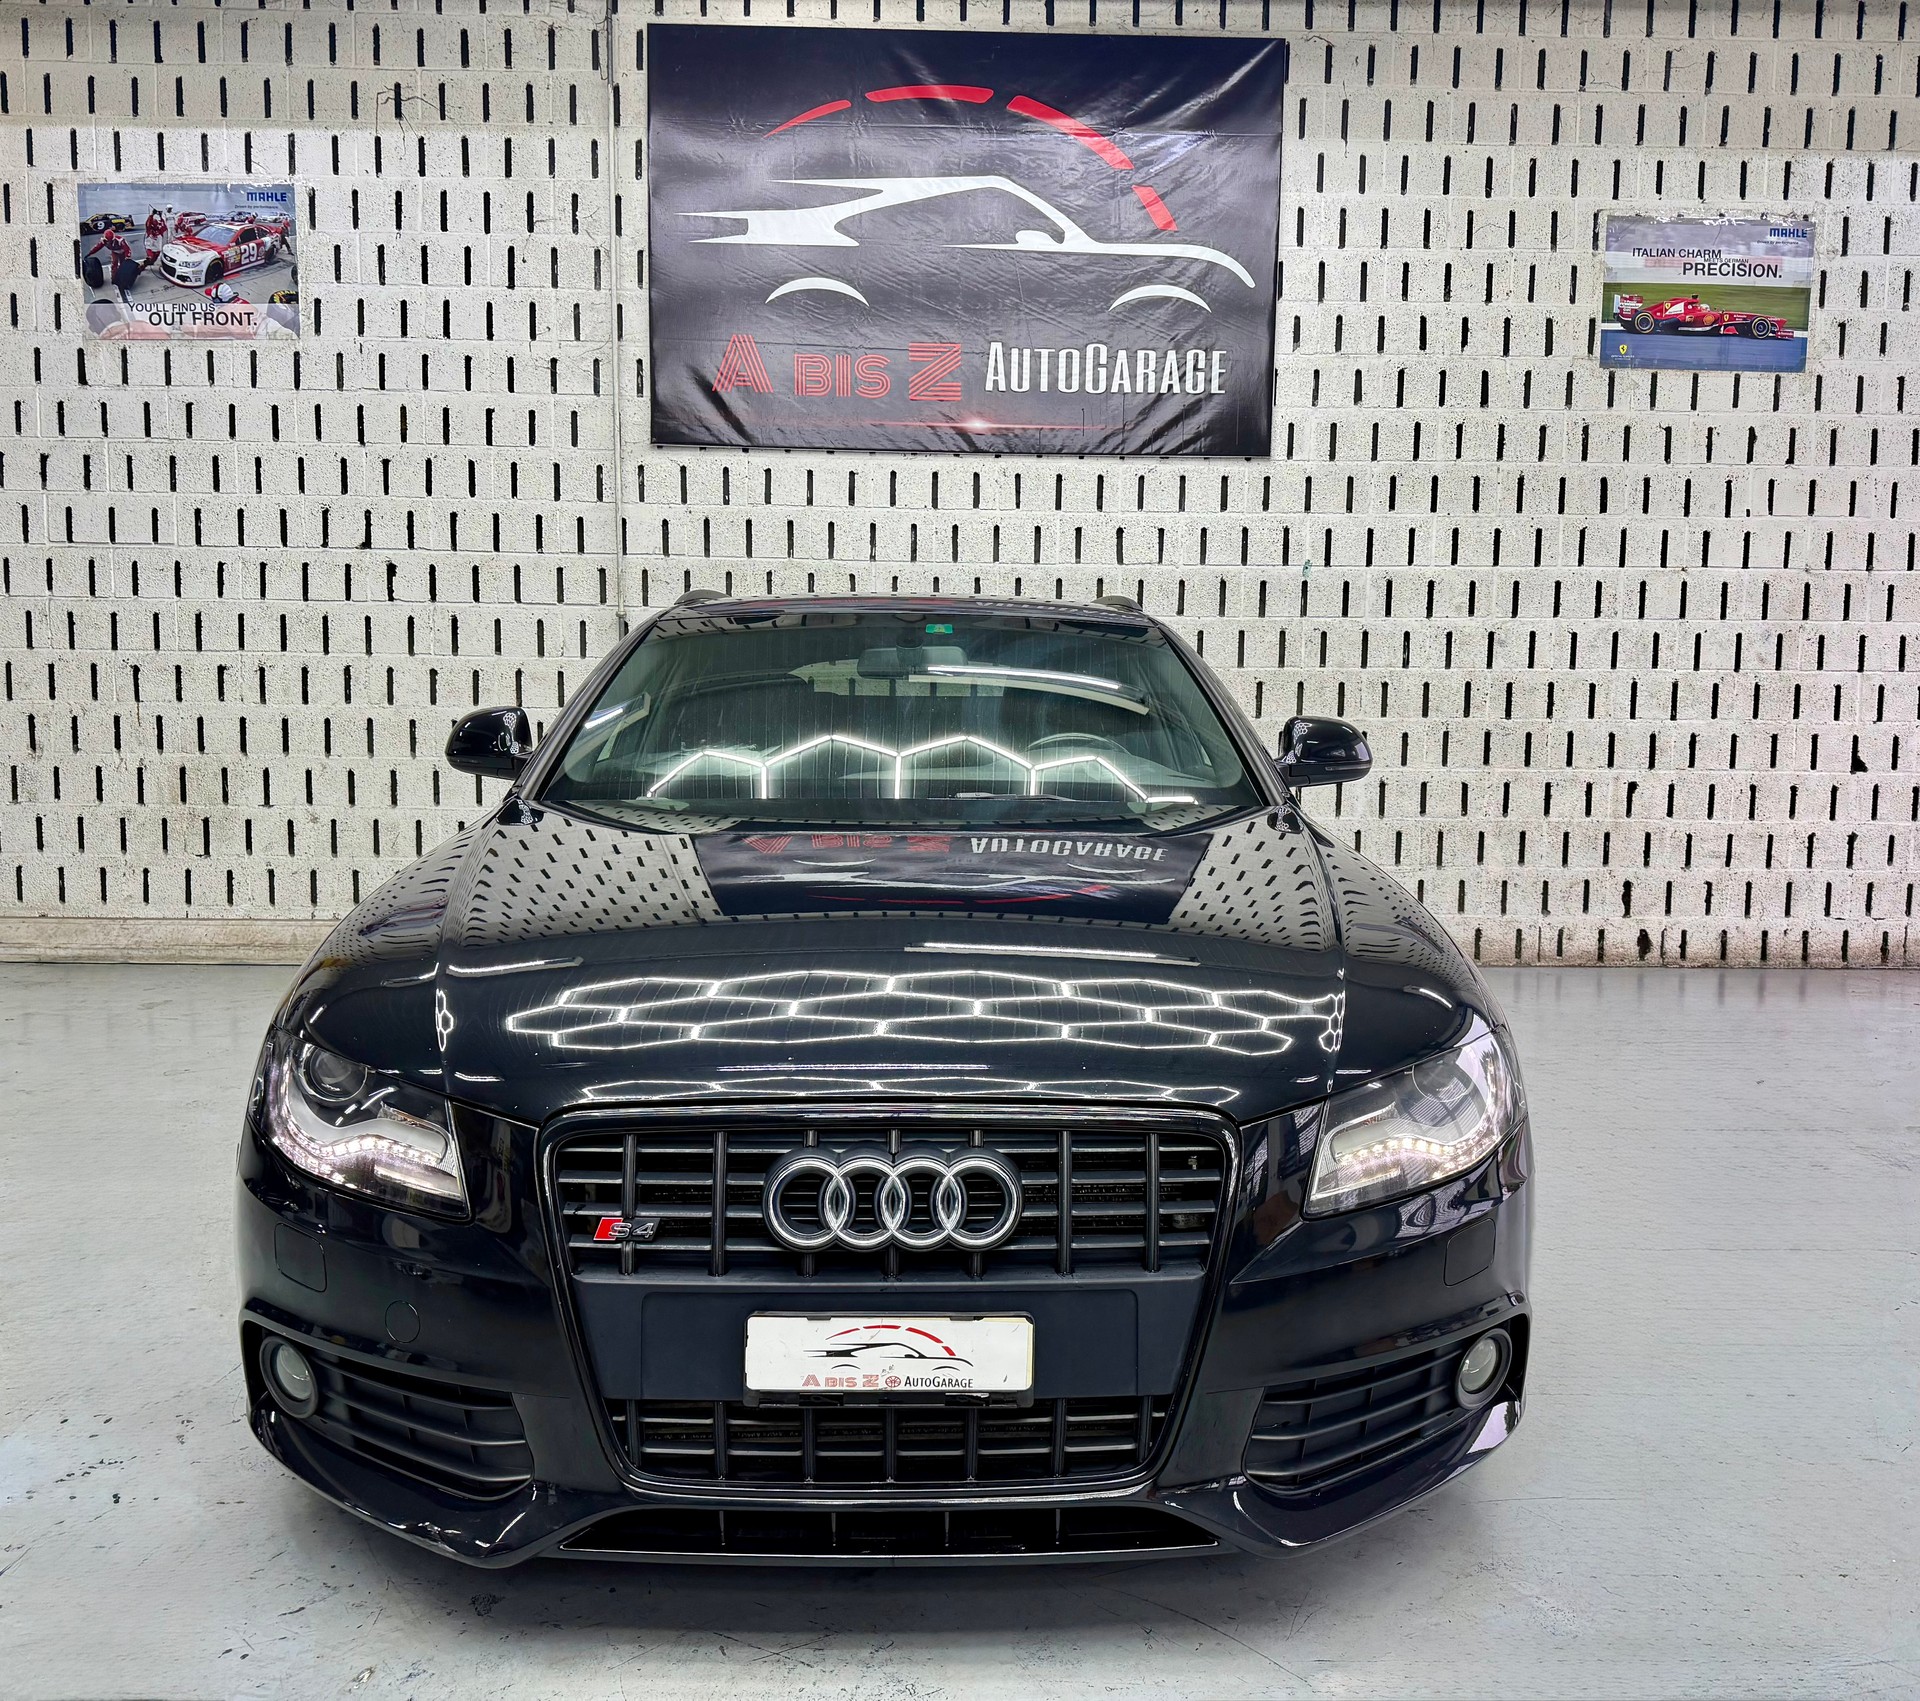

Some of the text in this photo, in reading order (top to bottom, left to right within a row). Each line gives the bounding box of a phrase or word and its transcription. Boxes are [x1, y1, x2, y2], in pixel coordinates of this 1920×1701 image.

[246, 191, 287, 202] MAHLE
[97, 221, 105, 230] 9
[1769, 227, 1808, 238] MAHLE
[240, 242, 257, 265] 29
[1632, 247, 1722, 259] ITALIAN CHARM
[1682, 262, 1782, 279] PRECISION.
[128, 303, 215, 312] YOU'LL FIND US
[149, 312, 257, 326] OUT FRONT.
[711, 334, 774, 393] A
[794, 353, 891, 398] BIS
[908, 342, 962, 402] Z
[608, 1222, 654, 1238] S4
[802, 1374, 820, 1387] A
[824, 1377, 857, 1388] BIS
[862, 1374, 879, 1387] Z
